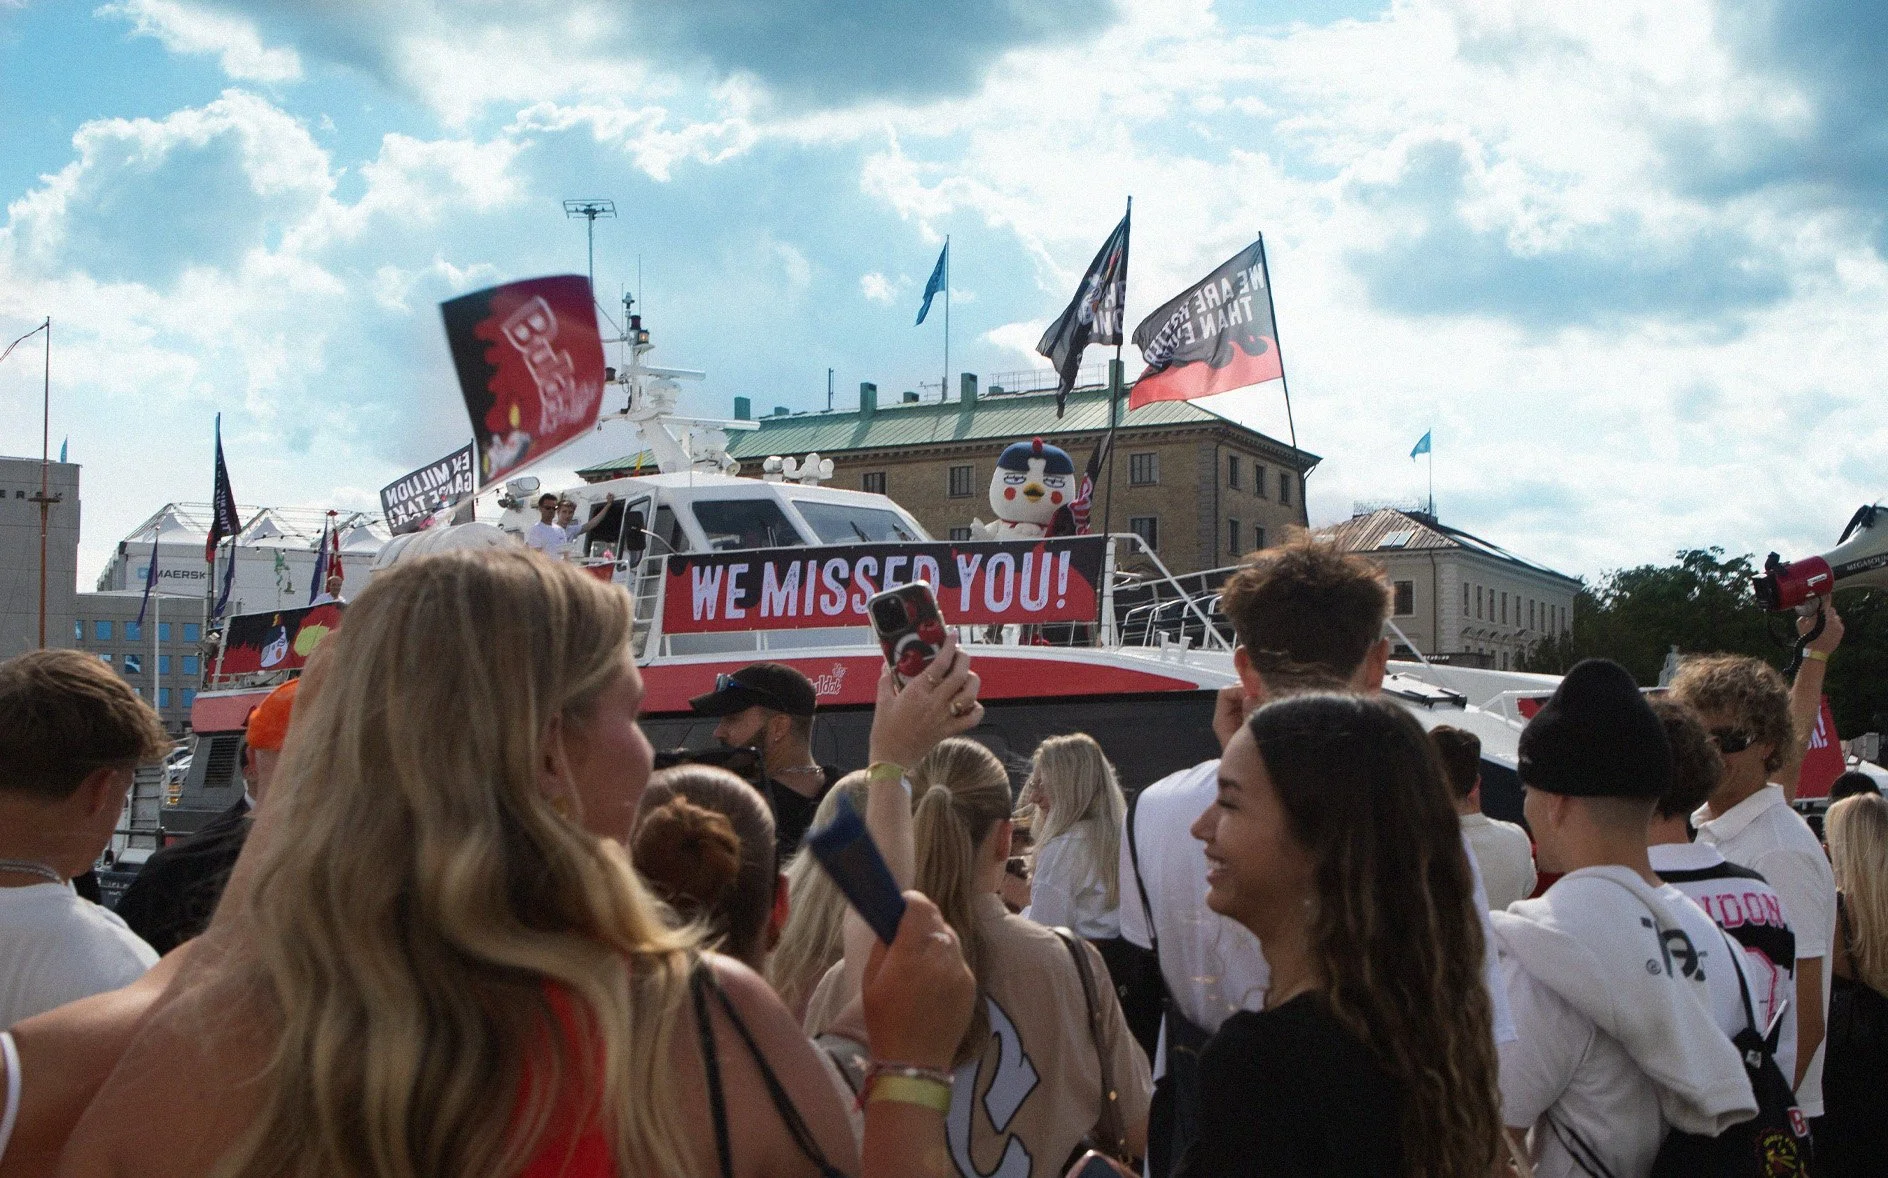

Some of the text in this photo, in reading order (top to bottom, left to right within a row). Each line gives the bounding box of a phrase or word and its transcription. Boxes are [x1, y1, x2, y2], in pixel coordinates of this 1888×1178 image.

[692, 550, 1072, 621] WE MISSED YOU!
